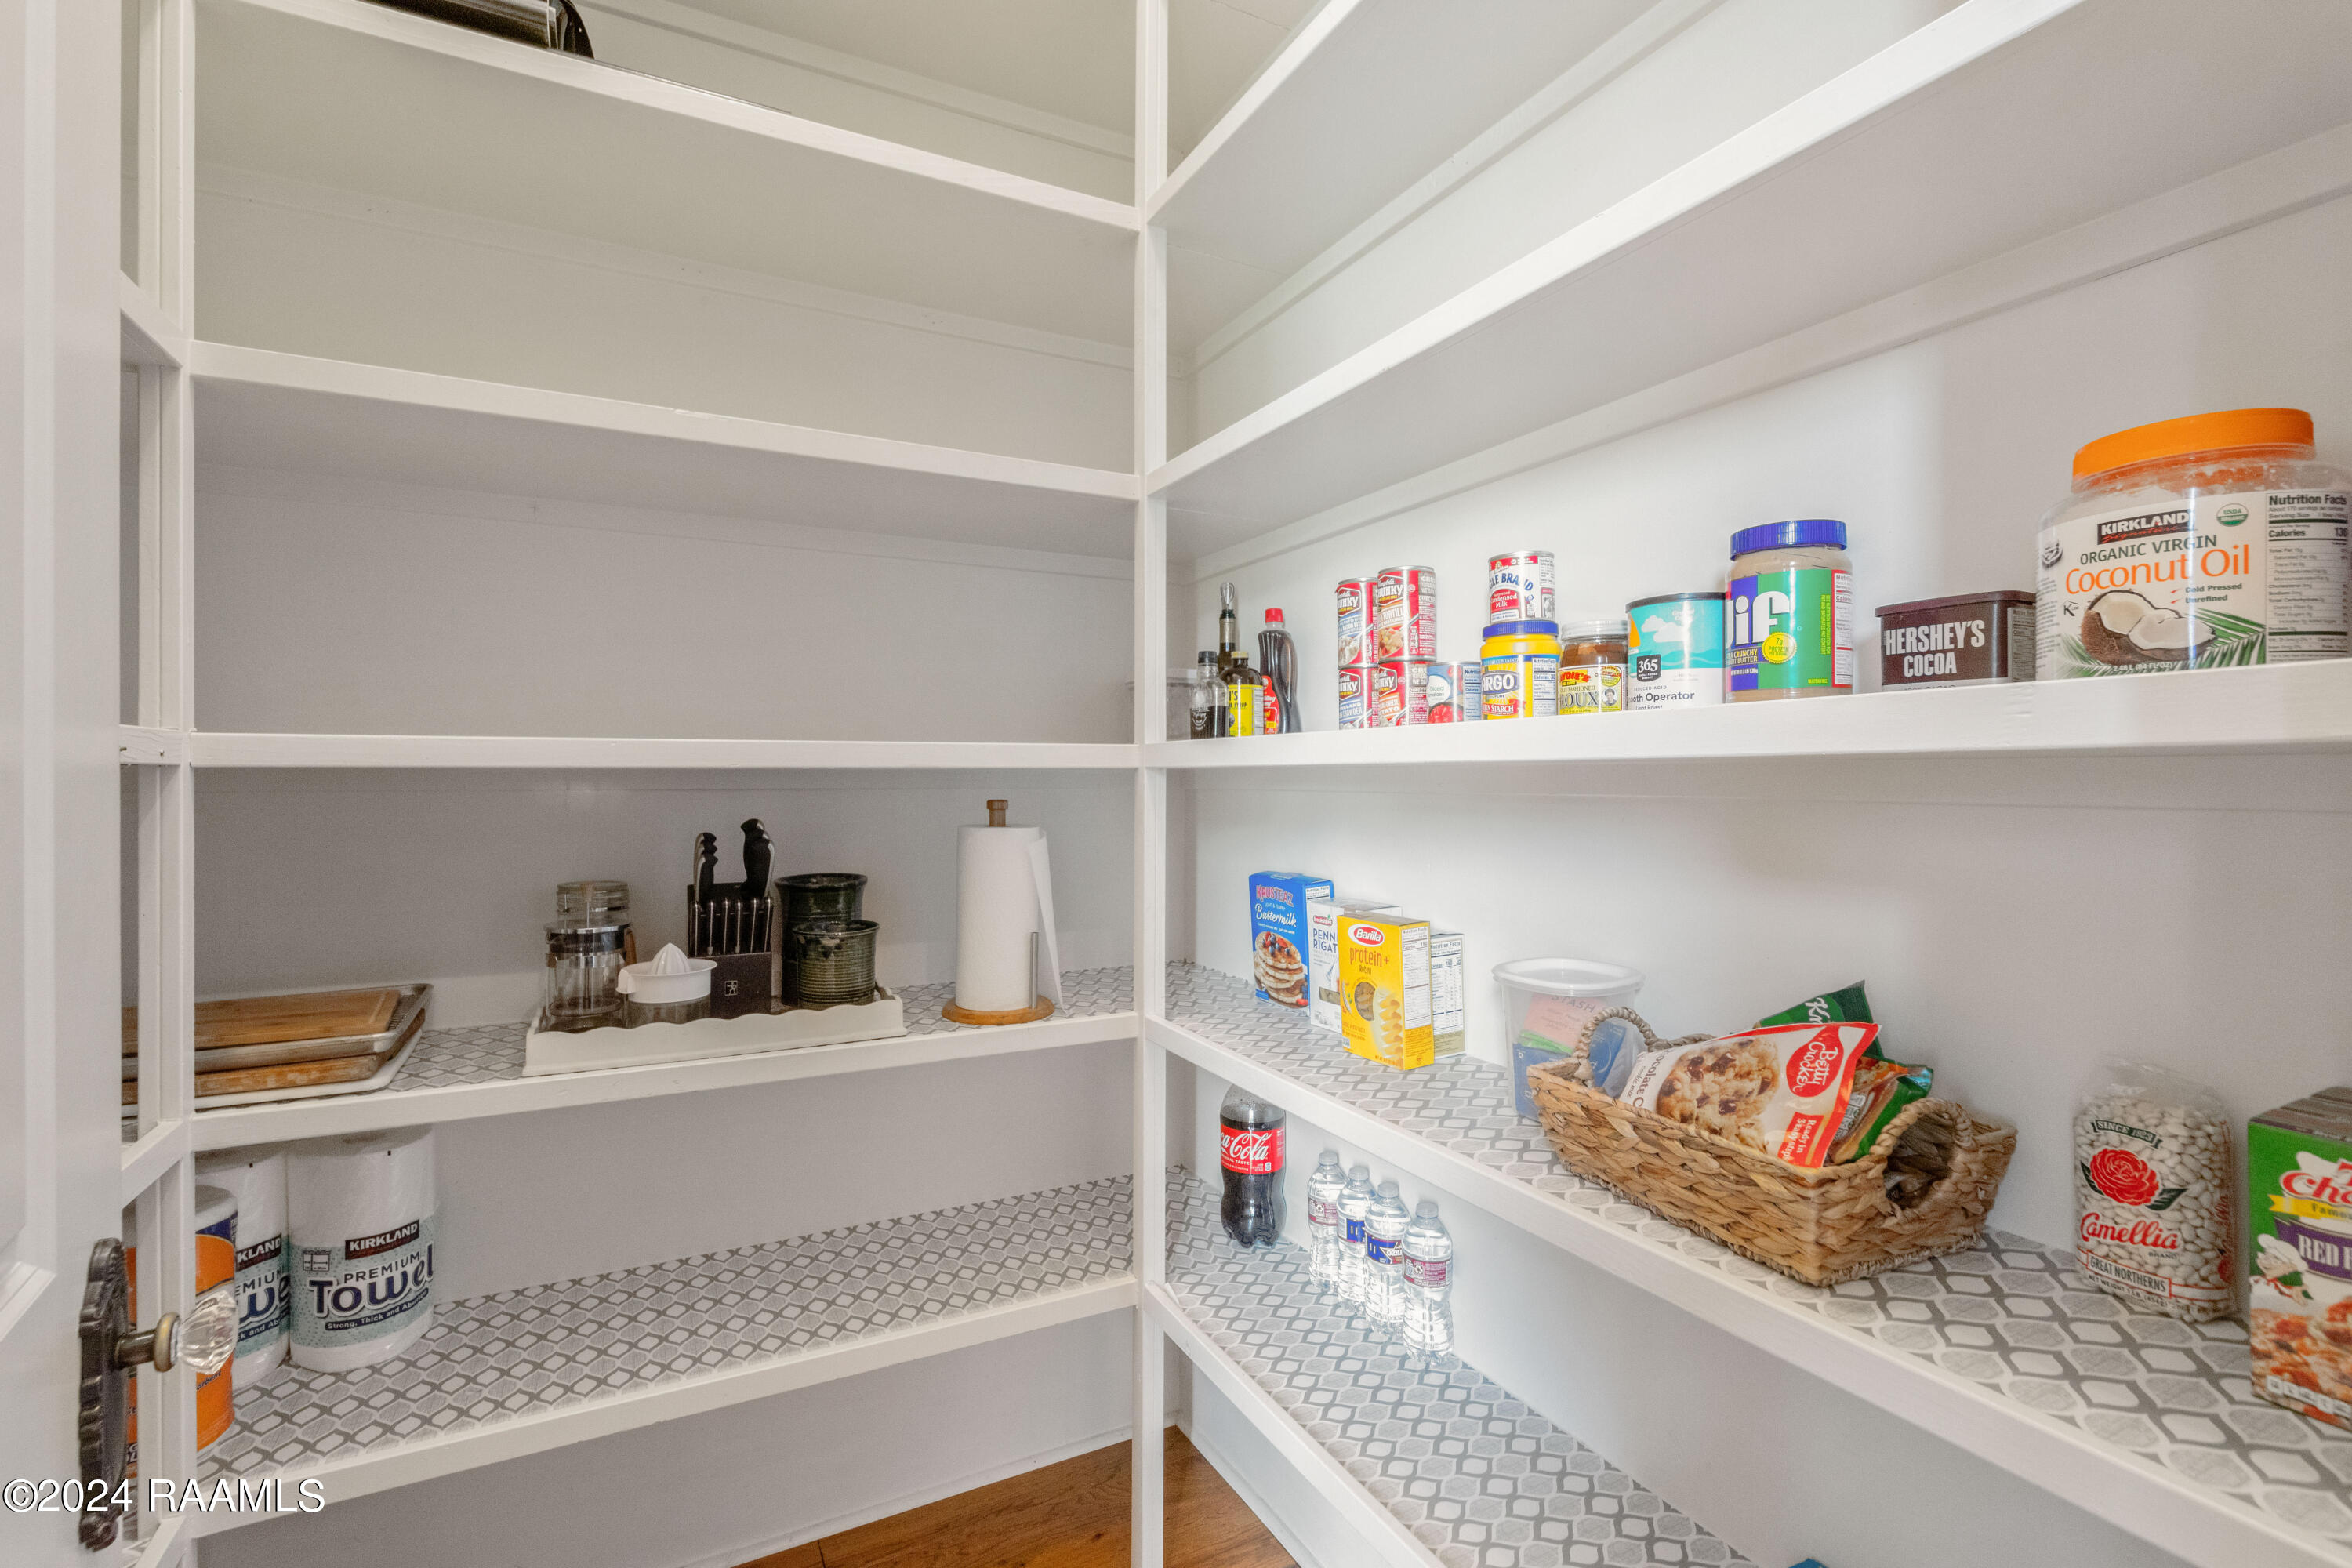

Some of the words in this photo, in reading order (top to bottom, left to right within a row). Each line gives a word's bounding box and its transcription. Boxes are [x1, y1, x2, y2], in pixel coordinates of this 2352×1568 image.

[2269, 494, 2321, 505] Nutrition
[2101, 512, 2190, 535] KIRKLAND
[2080, 543, 2147, 564] ORGANIC
[2152, 535, 2217, 554] VIRGIN
[2066, 554, 2189, 594] Coconut
[2201, 543, 2249, 577] Oil
[2207, 583, 2243, 592] Pressed
[2186, 595, 2227, 604] Unrefined
[1886, 619, 1985, 655] HERSHEY'S
[1733, 648, 1758, 658] CRUNCHY
[1904, 652, 1958, 677] COCOA
[1638, 659, 1658, 673] 365
[1482, 674, 1515, 691] ARGO
[1491, 703, 1514, 713] STARCH
[1646, 691, 1695, 703] Operator
[1256, 884, 1294, 908] KRUSTEAZ
[1254, 903, 1297, 927] Buttermilk
[1313, 927, 1336, 942] PENN
[1313, 938, 1338, 953] RIGAT
[1356, 928, 1381, 942] Barilla
[1805, 997, 1831, 1025] Kn
[1814, 1047, 1839, 1085] Betty
[1798, 1119, 1817, 1144] Ready
[2096, 1120, 2130, 1134] SINCE
[2282, 1173, 2352, 1204] Ch
[2311, 1203, 2352, 1219] Famo
[350, 1223, 418, 1252] KIRKLAND
[2080, 1212, 2178, 1250] Camellia
[237, 1236, 281, 1264] KLAND
[2298, 1233, 2339, 1267] RED
[343, 1250, 420, 1284] PREMIUM
[2090, 1256, 2113, 1275] GREAT
[2114, 1264, 2166, 1293] NORTHERNS
[308, 1243, 434, 1316] Towel
[249, 1323, 265, 1337] and
[327, 1321, 358, 1330] Strong,
[361, 1314, 384, 1324] Thick
[386, 1307, 400, 1316] and
[196, 1371, 222, 1390] orbent
